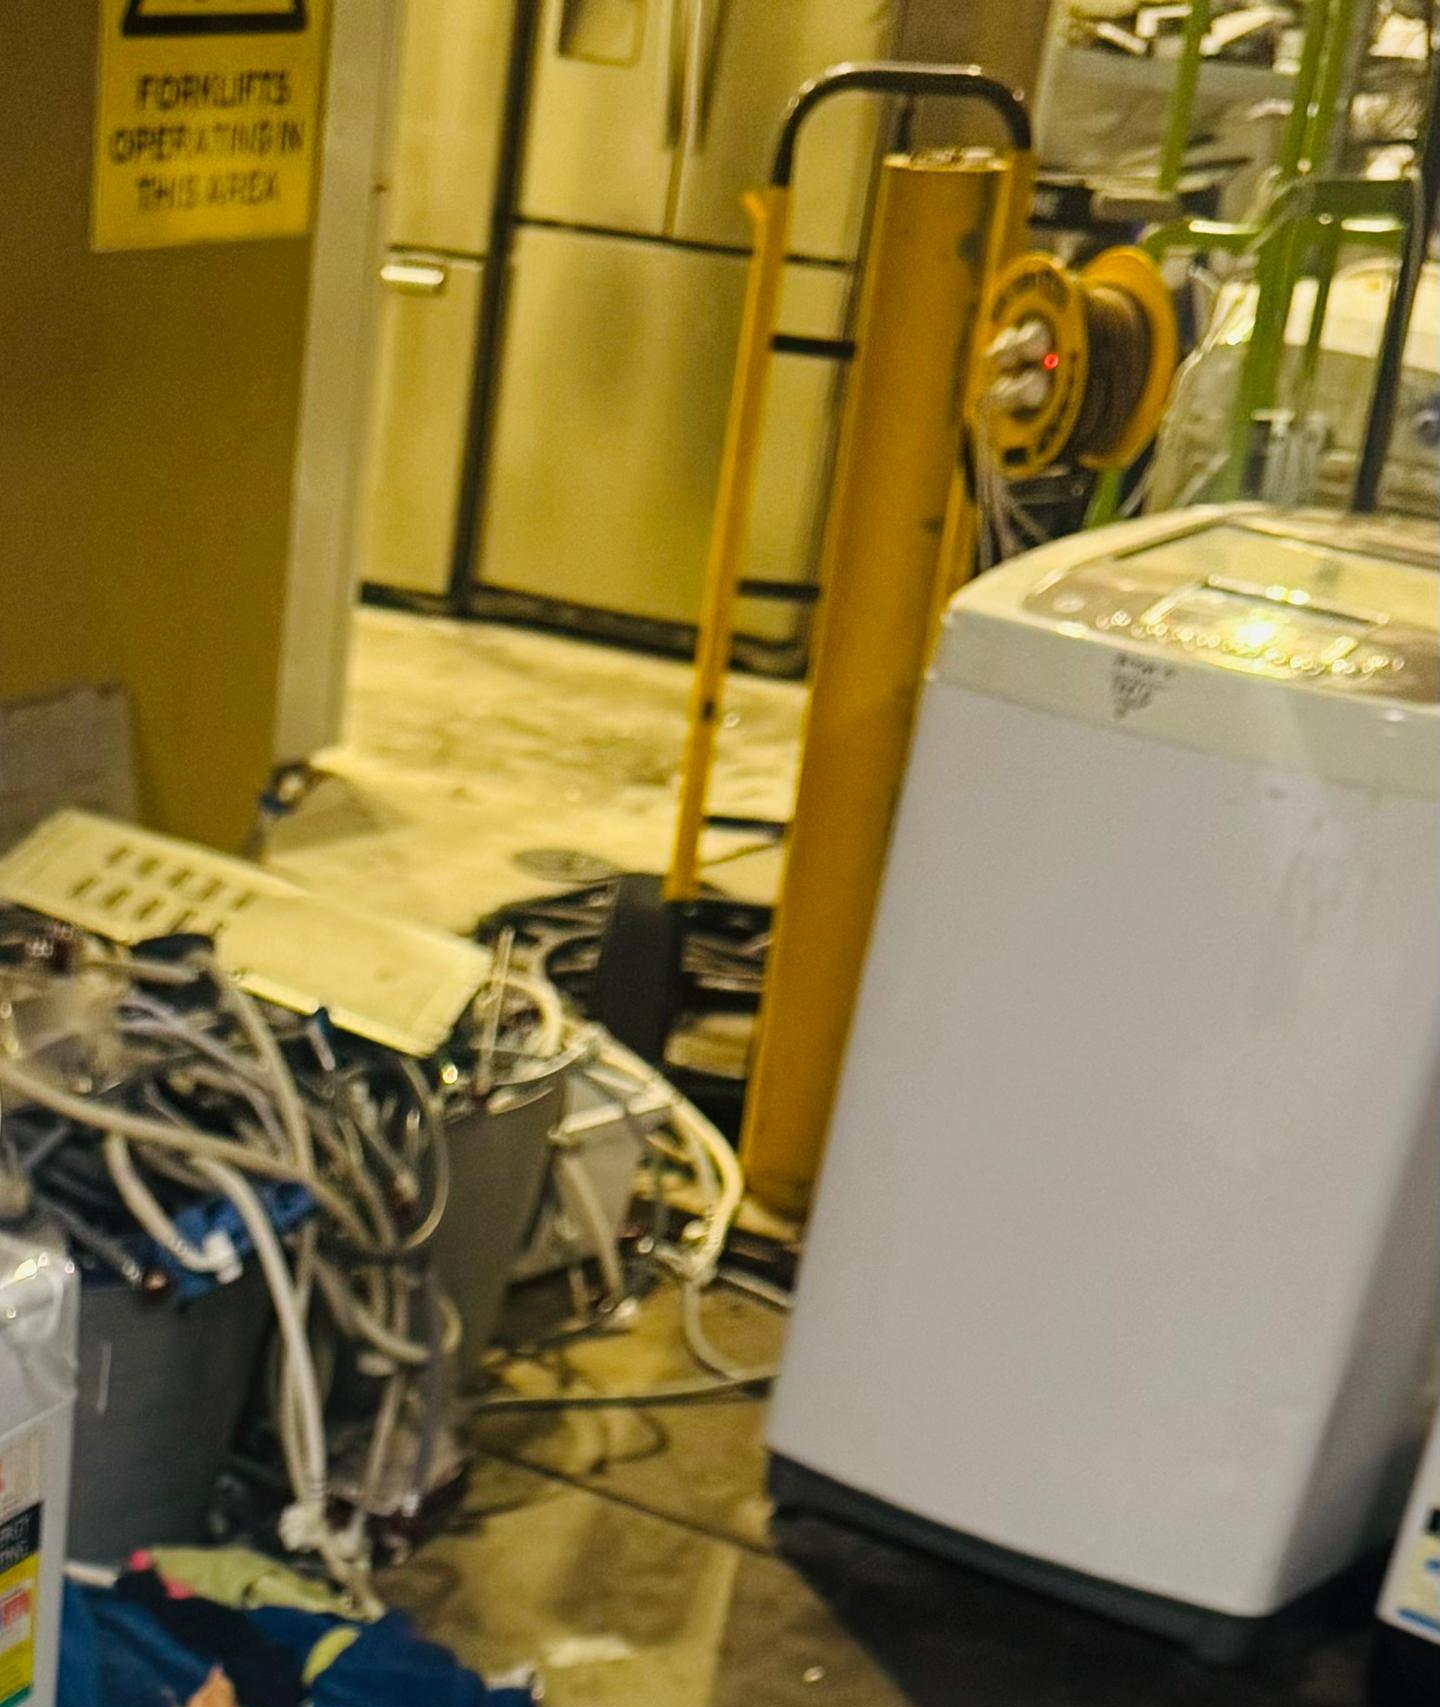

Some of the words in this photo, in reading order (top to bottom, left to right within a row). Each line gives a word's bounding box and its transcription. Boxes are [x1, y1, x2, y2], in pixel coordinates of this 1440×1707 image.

[137, 70, 291, 109] FORKLIFTS
[112, 121, 269, 163] OPERATING
[280, 119, 304, 153] IN
[137, 174, 196, 210] THIS
[206, 171, 279, 205] AREA
